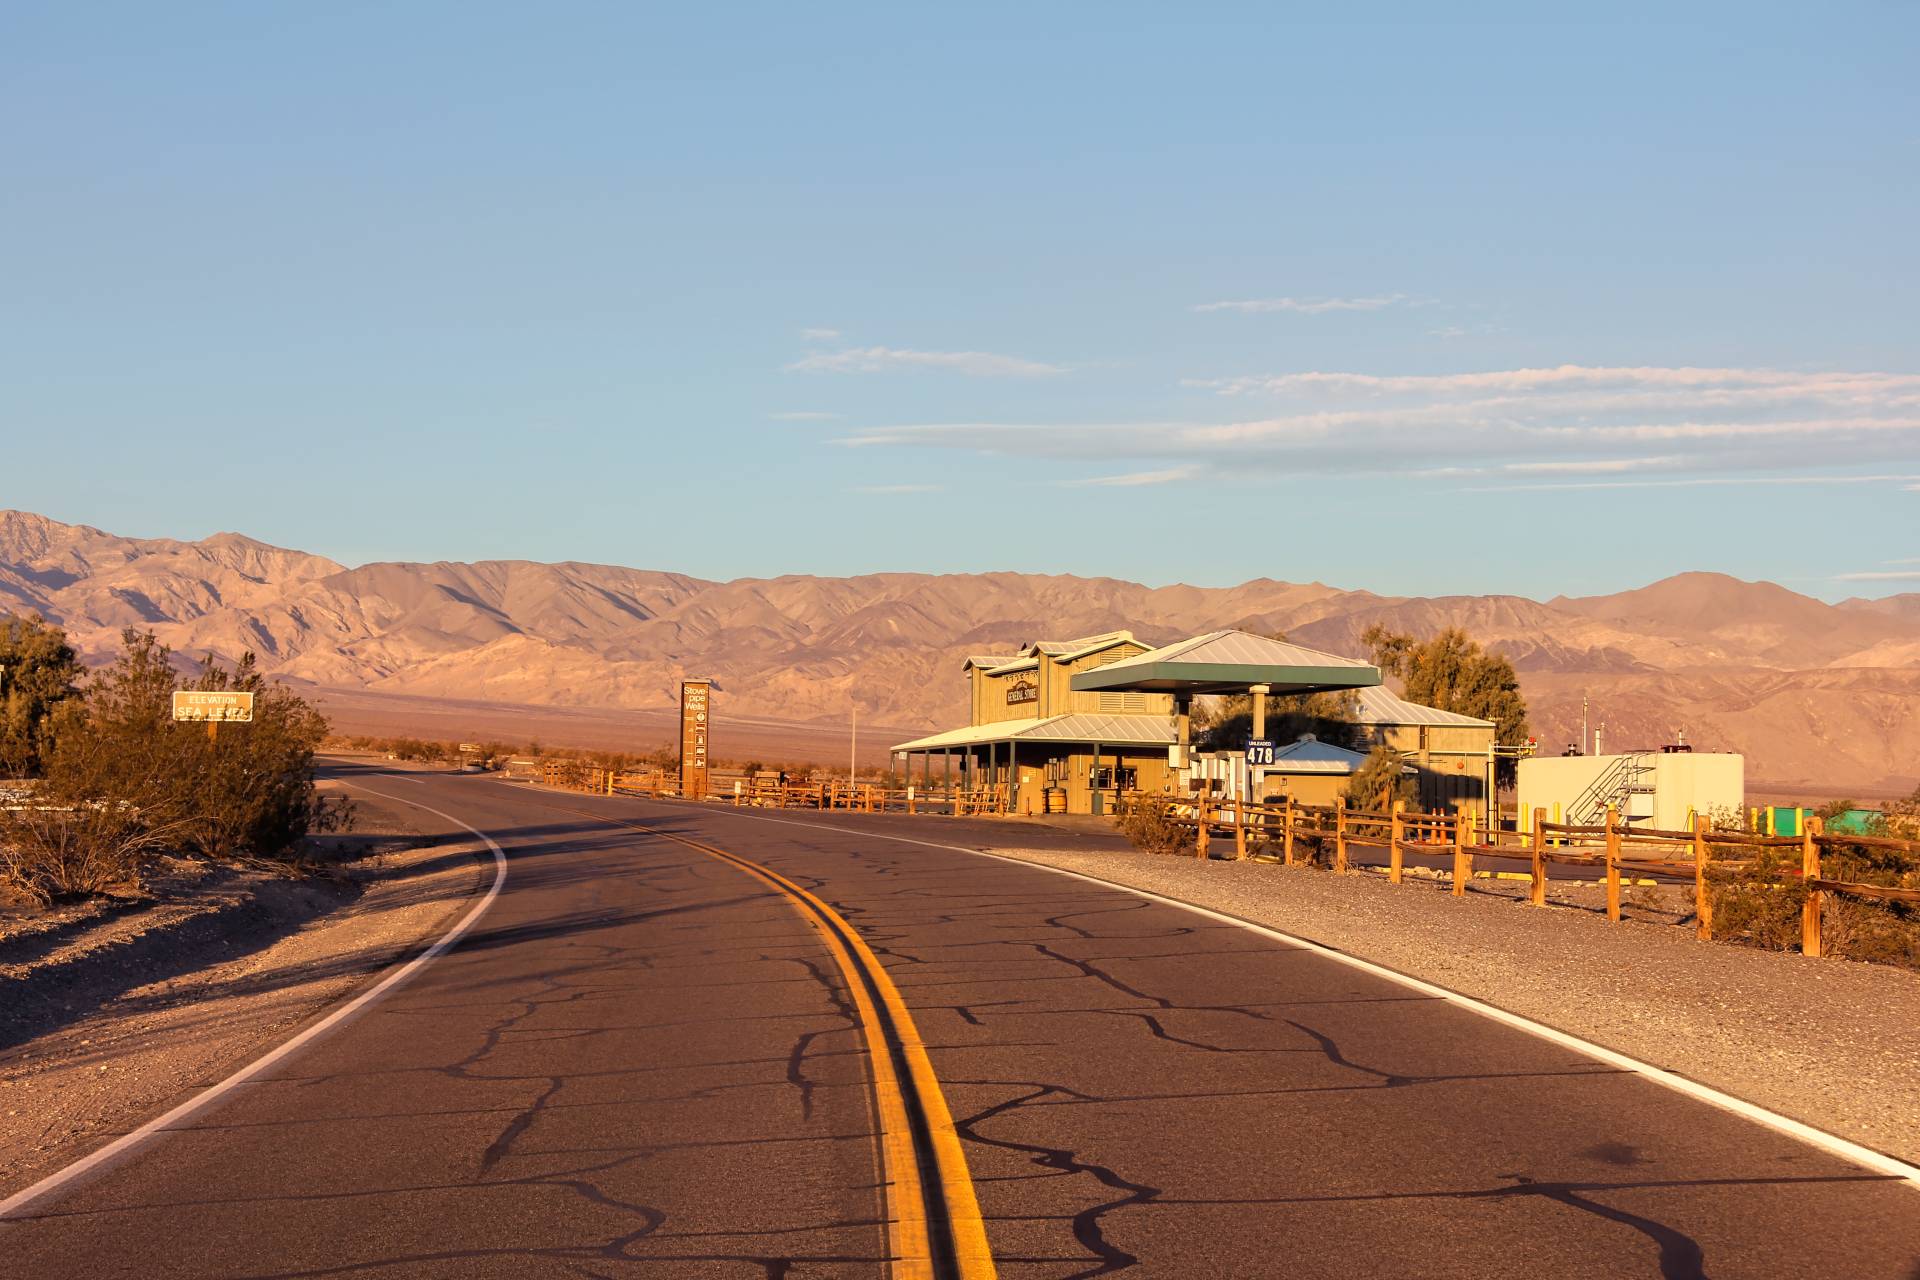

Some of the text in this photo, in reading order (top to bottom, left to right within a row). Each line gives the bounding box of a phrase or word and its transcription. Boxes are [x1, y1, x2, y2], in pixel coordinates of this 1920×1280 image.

[189, 696, 237, 705] ELEVATION
[685, 702, 705, 711] Wells
[178, 707, 202, 717] SEA
[1247, 748, 1273, 764] 478
